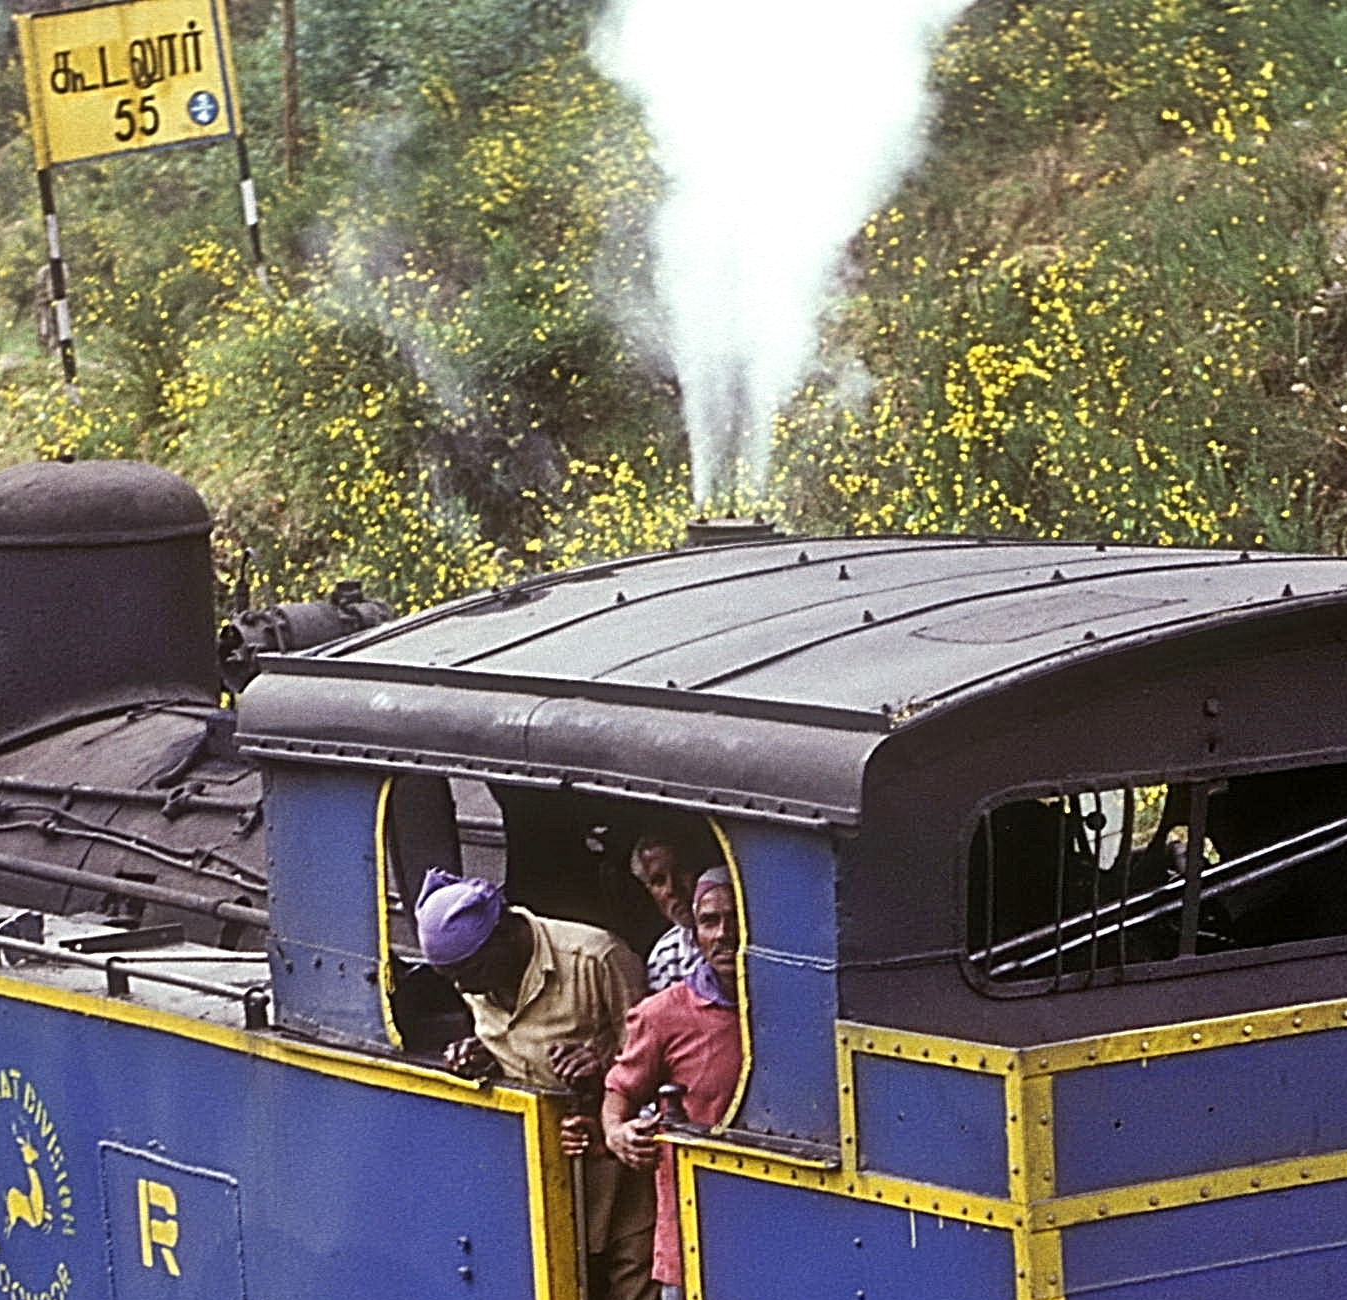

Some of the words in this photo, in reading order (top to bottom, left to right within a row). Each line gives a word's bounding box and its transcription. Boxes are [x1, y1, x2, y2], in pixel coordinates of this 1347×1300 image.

[50, 20, 204, 94] கூடலூர்
[114, 95, 160, 142] 55
[137, 1178, 181, 1277] R
